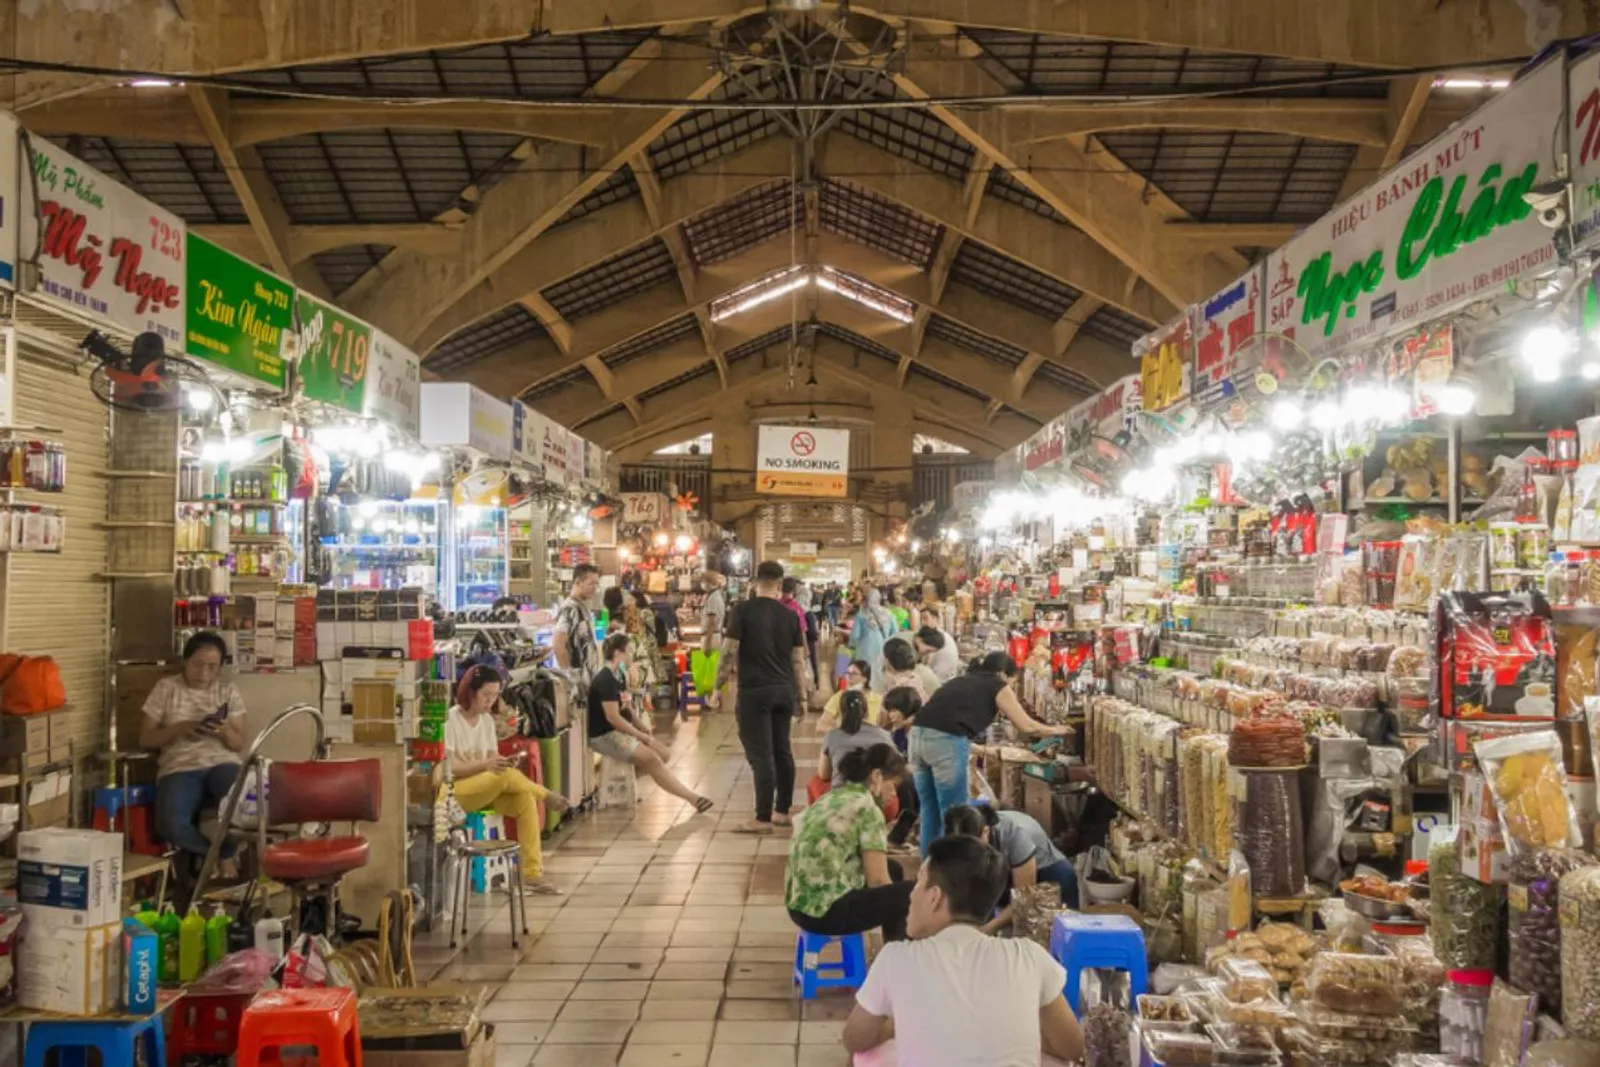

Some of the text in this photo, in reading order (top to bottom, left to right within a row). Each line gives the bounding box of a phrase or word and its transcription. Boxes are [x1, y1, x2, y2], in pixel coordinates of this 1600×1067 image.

[1332, 125, 1485, 241] HIỆU BÁNH MỨT
[149, 215, 182, 262] 723
[110, 237, 180, 315] Ngọc
[195, 279, 236, 328] Kim
[1297, 250, 1384, 337] Ngọc
[331, 320, 367, 383] 719
[766, 457, 841, 470] NO SMOKING
